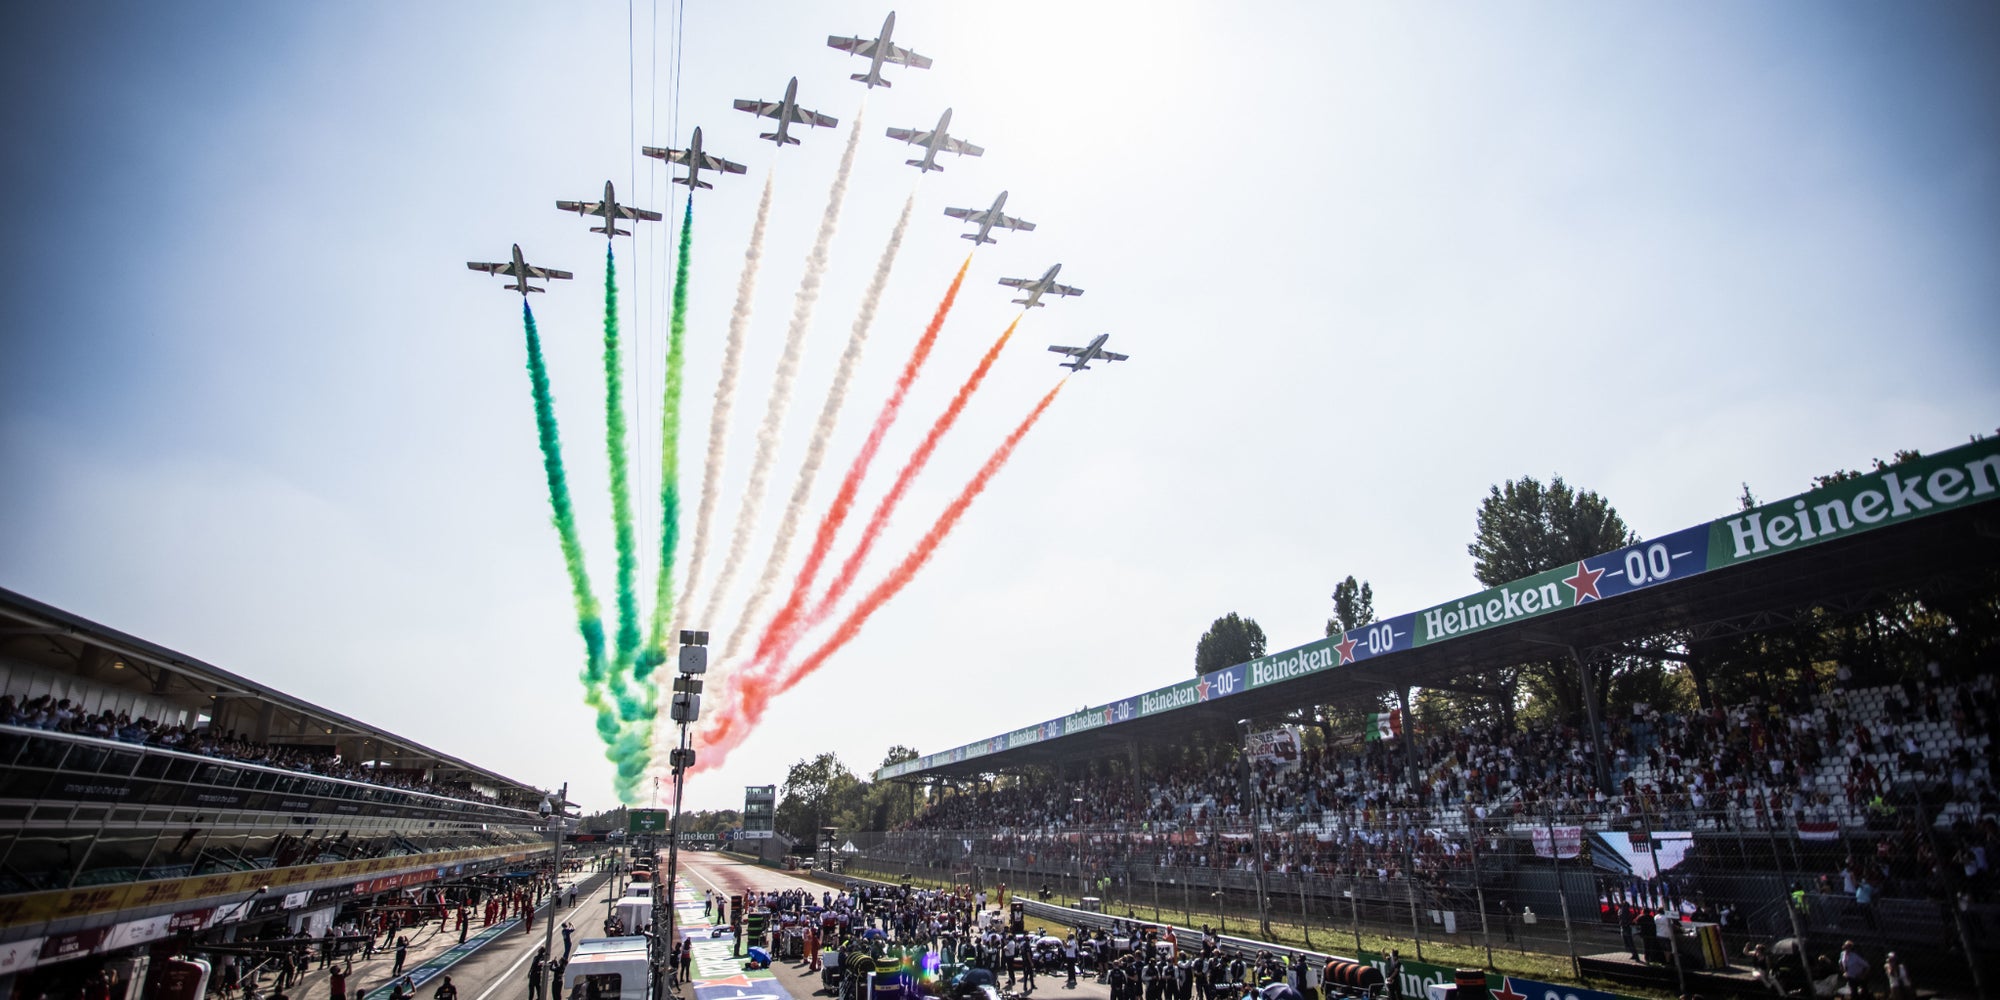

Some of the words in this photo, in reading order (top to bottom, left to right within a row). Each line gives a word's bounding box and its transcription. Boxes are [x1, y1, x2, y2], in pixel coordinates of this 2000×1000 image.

[1727, 453, 2000, 558] Heineken
[1424, 582, 1562, 640] Heineken
[1252, 647, 1333, 685] Heineken
[1142, 686, 1195, 714] Heineken
[1065, 711, 1103, 734] Heineken
[678, 831, 715, 841] ineken
